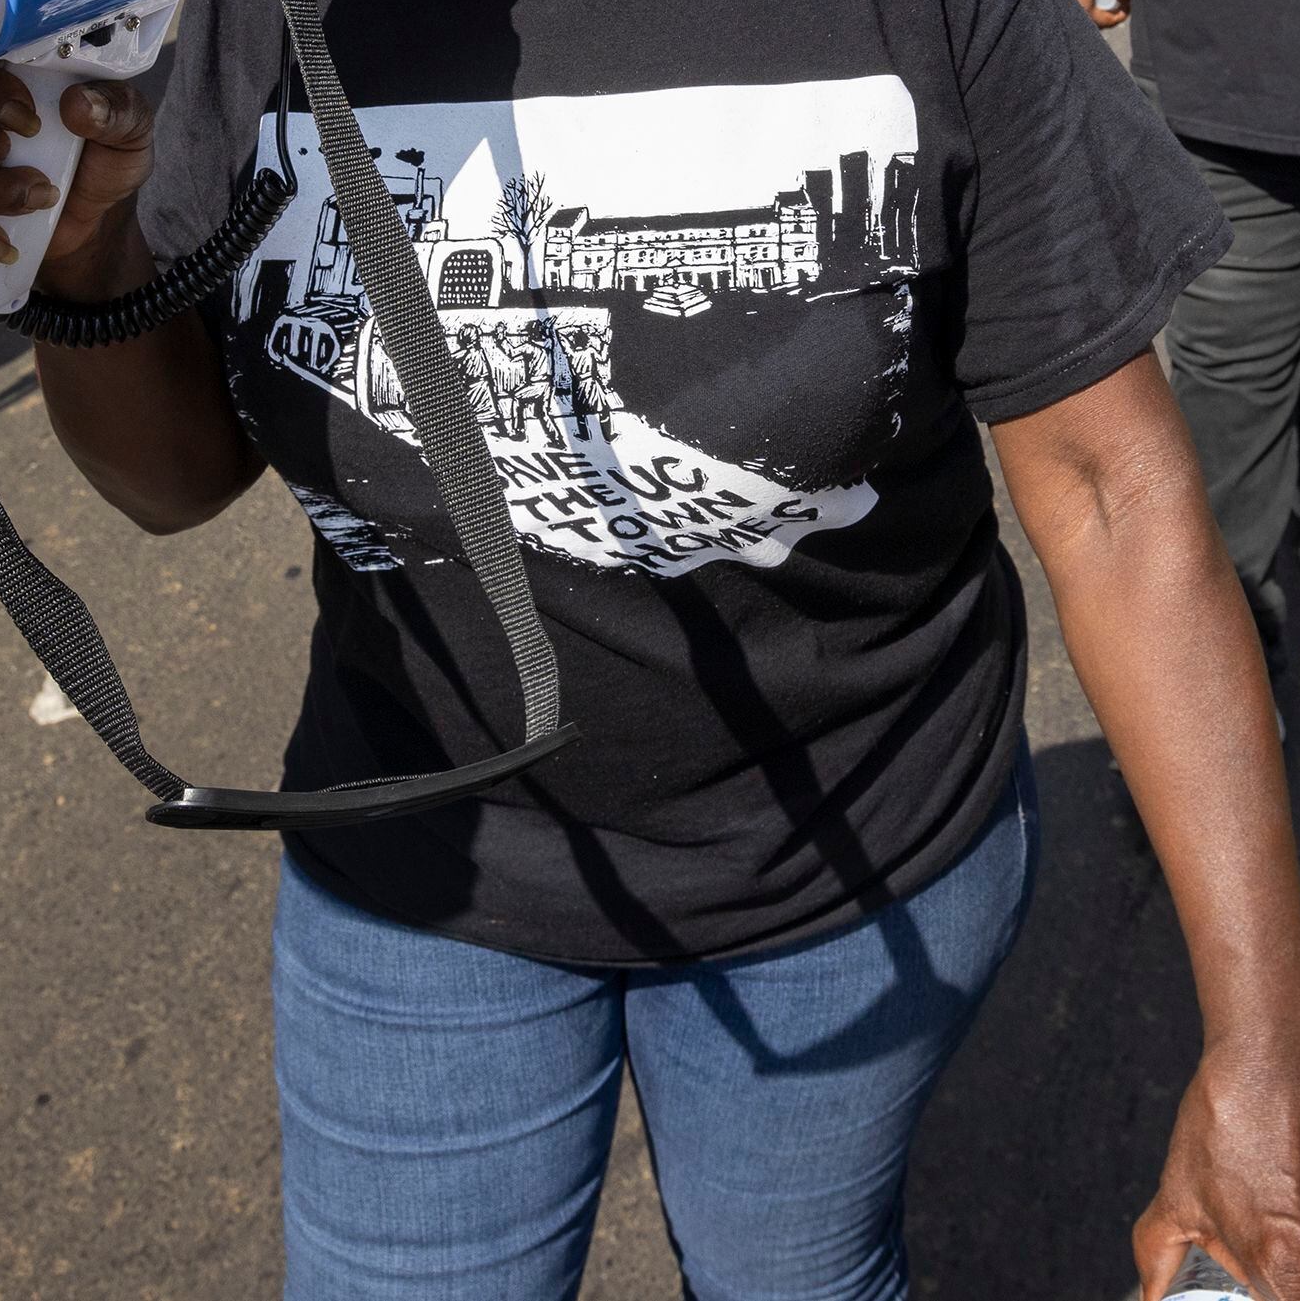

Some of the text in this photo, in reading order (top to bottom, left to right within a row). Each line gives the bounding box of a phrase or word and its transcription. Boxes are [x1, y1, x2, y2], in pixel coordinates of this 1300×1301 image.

[57, 18, 110, 45] SIREN OFF
[510, 455, 709, 523] THE UC
[548, 489, 757, 543] TOWN
[606, 499, 819, 569] HOMES
